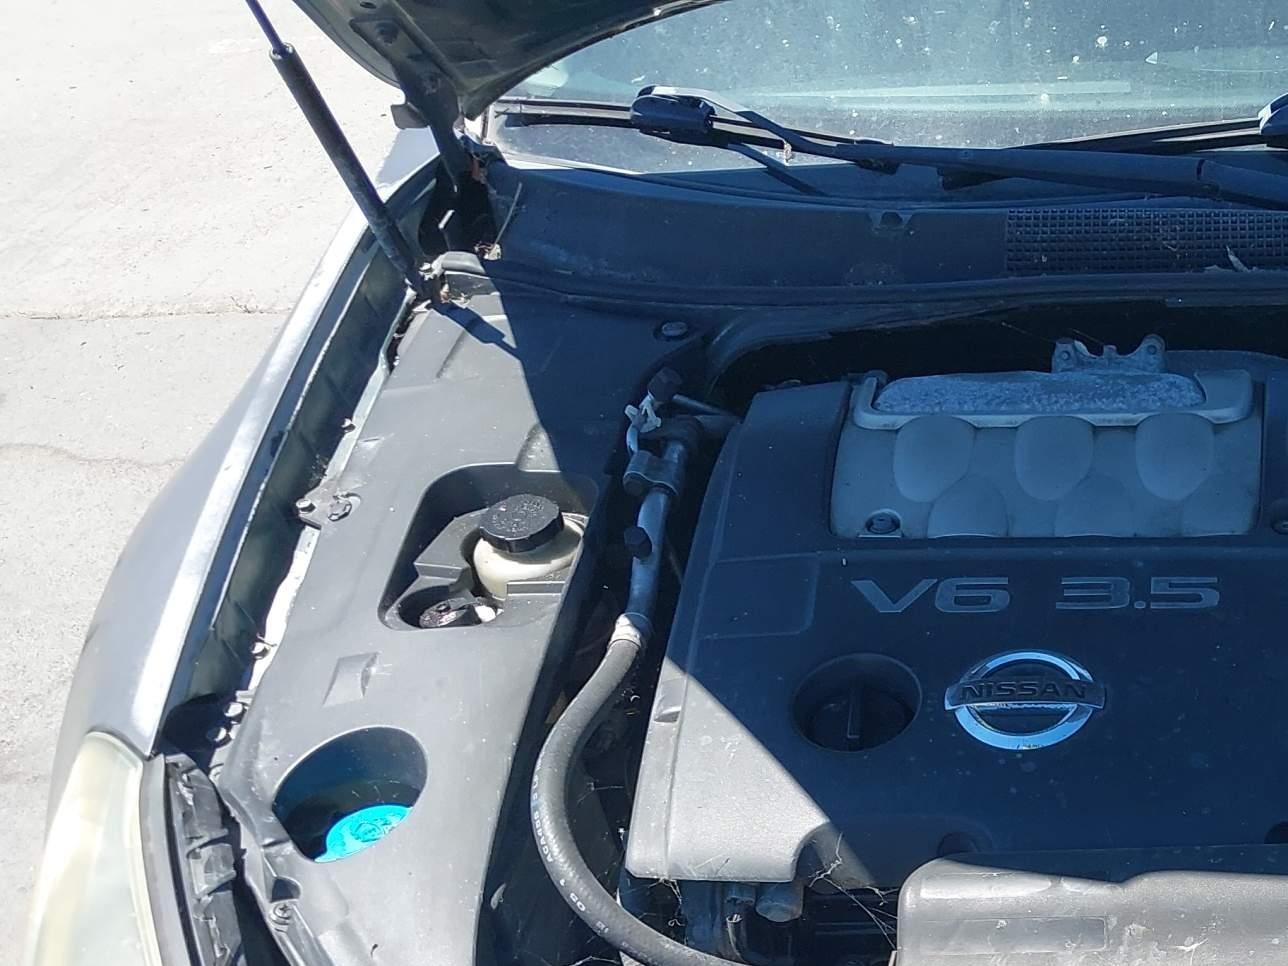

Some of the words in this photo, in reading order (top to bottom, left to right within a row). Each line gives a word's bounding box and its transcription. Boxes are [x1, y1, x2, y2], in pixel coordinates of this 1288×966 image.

[851, 577, 1010, 612] V6
[1055, 576, 1220, 609] 3.5
[960, 680, 1089, 699] NISSAN
